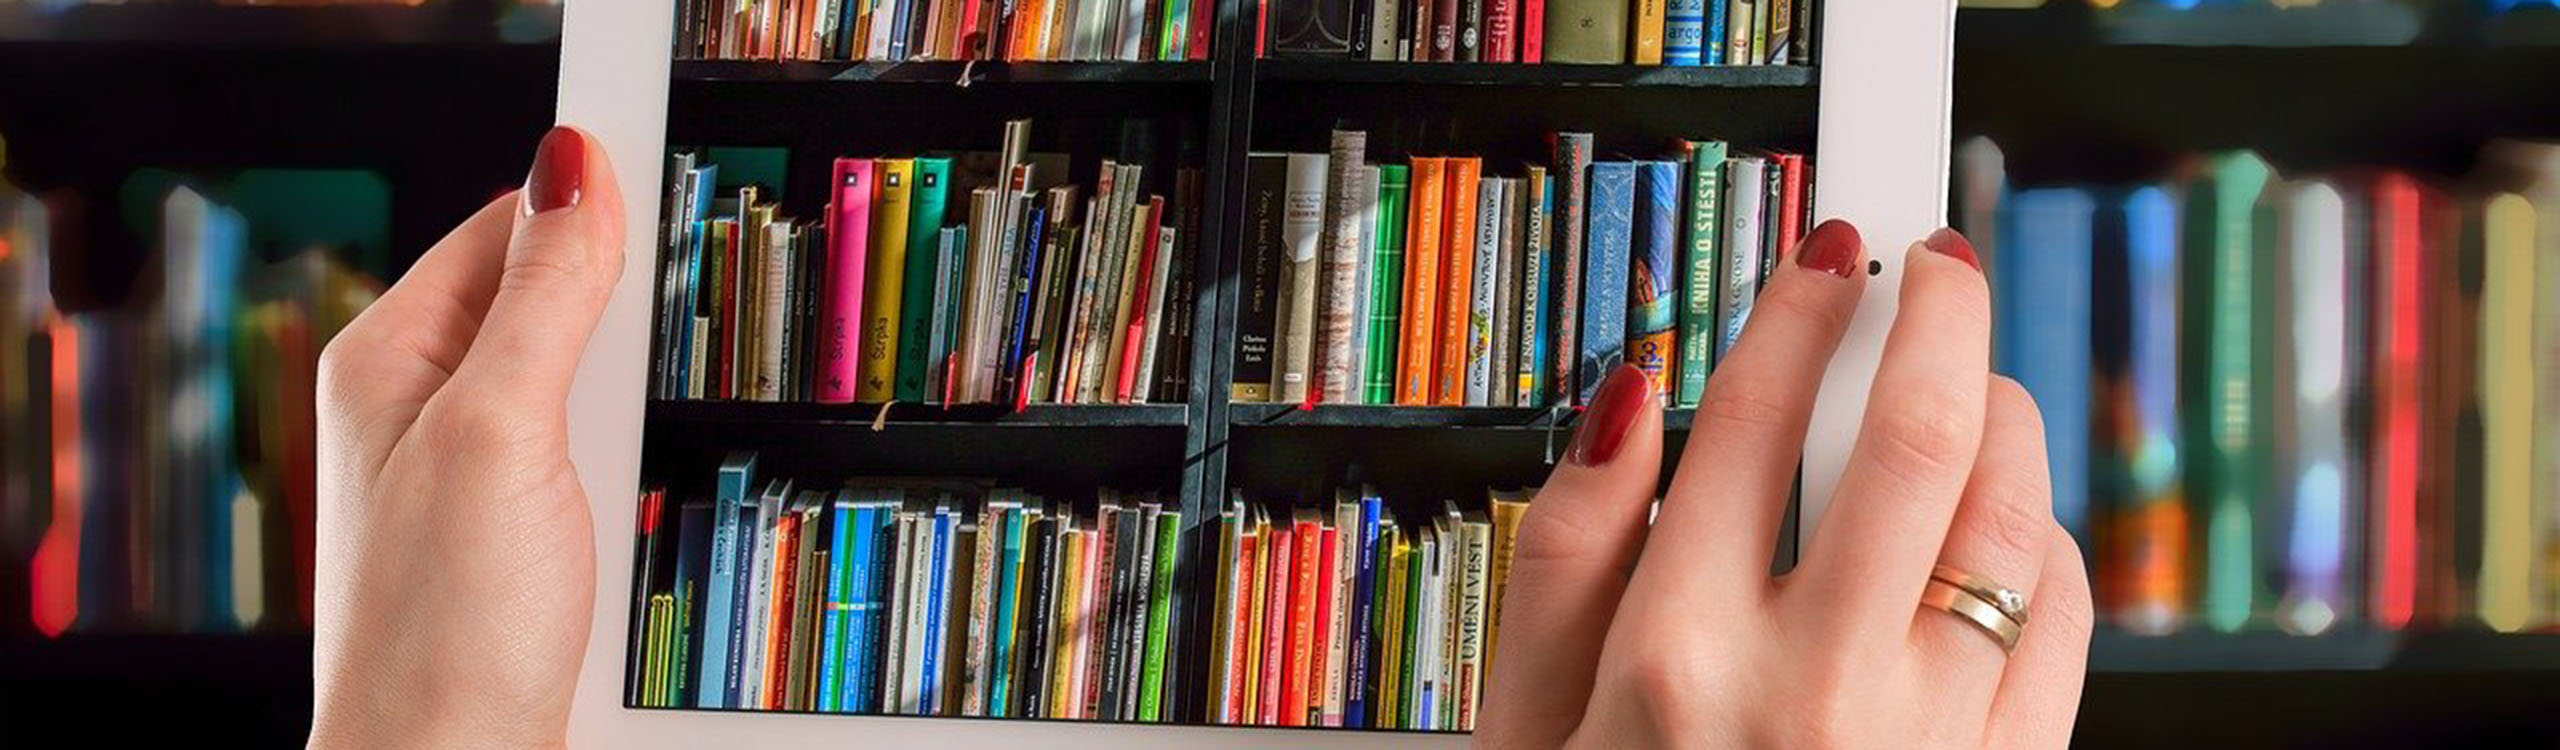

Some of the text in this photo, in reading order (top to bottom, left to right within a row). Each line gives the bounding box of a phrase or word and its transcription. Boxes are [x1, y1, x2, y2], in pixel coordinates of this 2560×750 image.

[1667, 26, 1700, 44] argo
[1695, 239, 1712, 252] O
[1690, 258, 1711, 314] KNIHA
